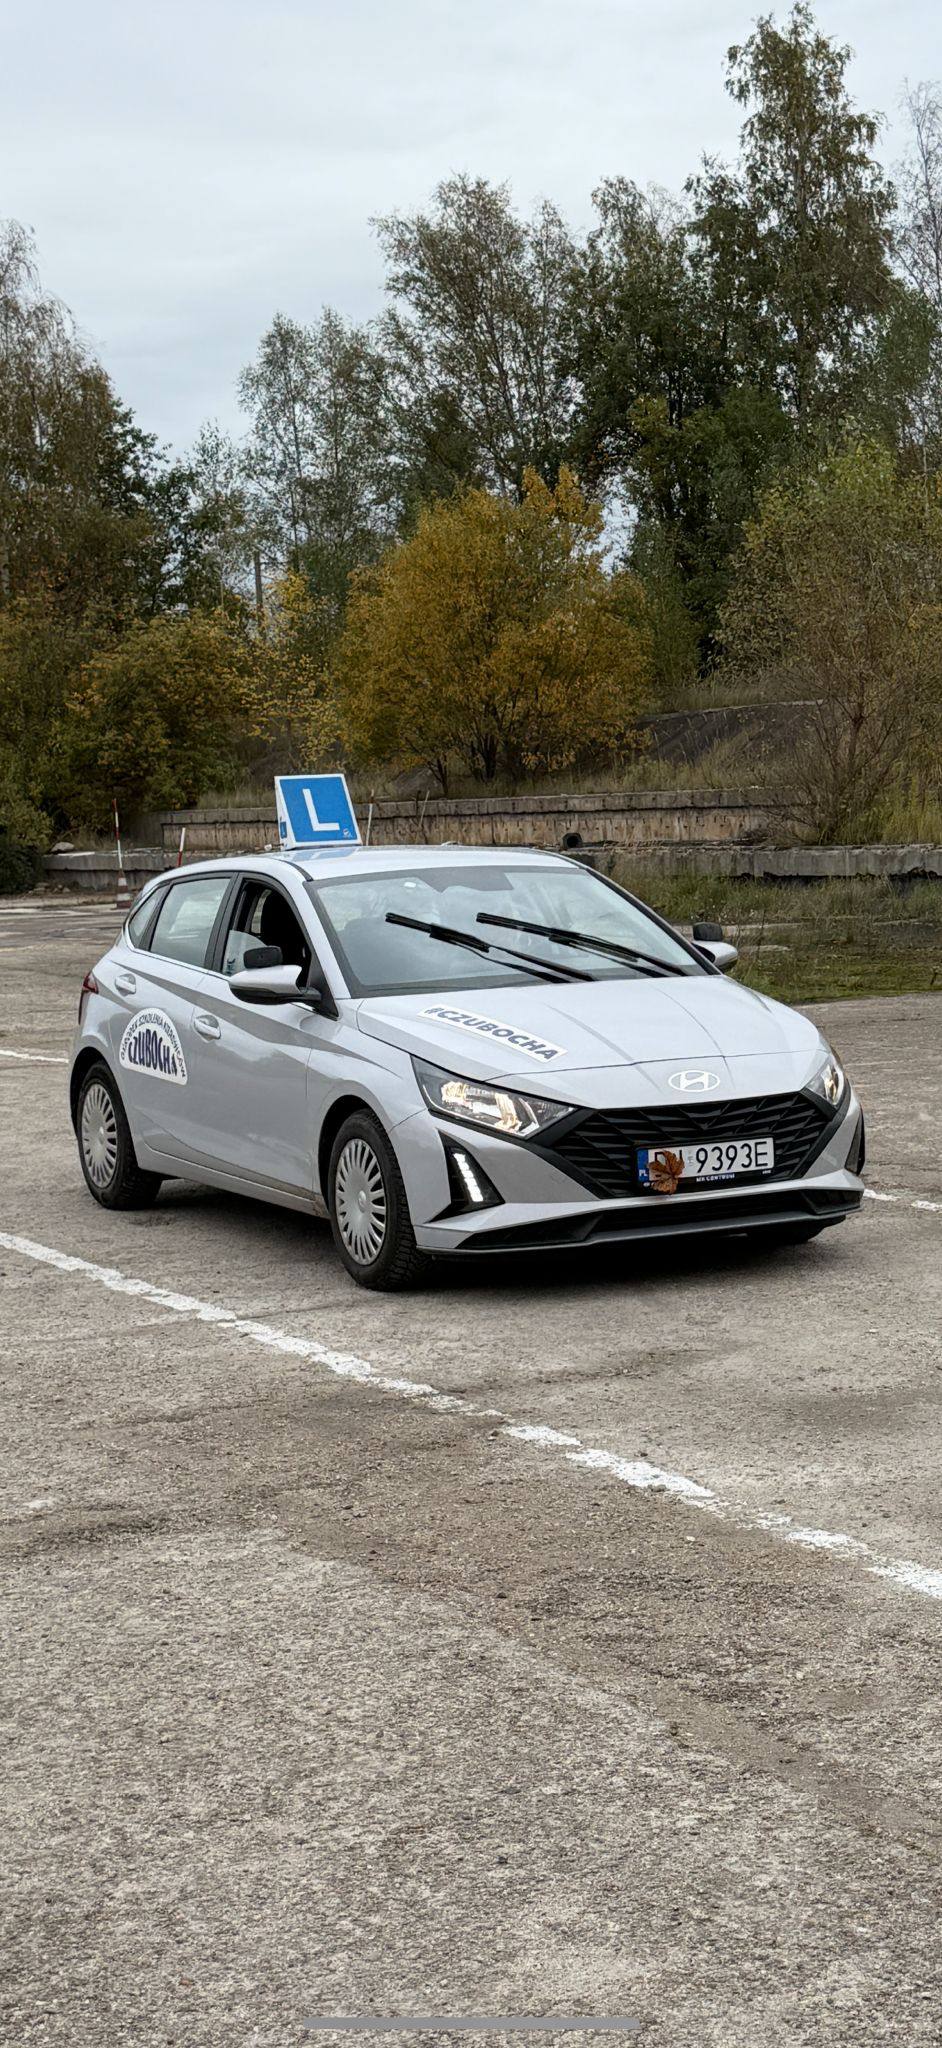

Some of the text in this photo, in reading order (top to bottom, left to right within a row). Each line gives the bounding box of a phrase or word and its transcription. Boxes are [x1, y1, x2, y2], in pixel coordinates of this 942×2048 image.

[302, 788, 340, 831] L
[128, 1028, 177, 1076] CZUBOCHA
[424, 1007, 559, 1060] #CZUBOCHA
[639, 1169, 648, 1177] PL
[695, 1141, 768, 1173] 9393E
